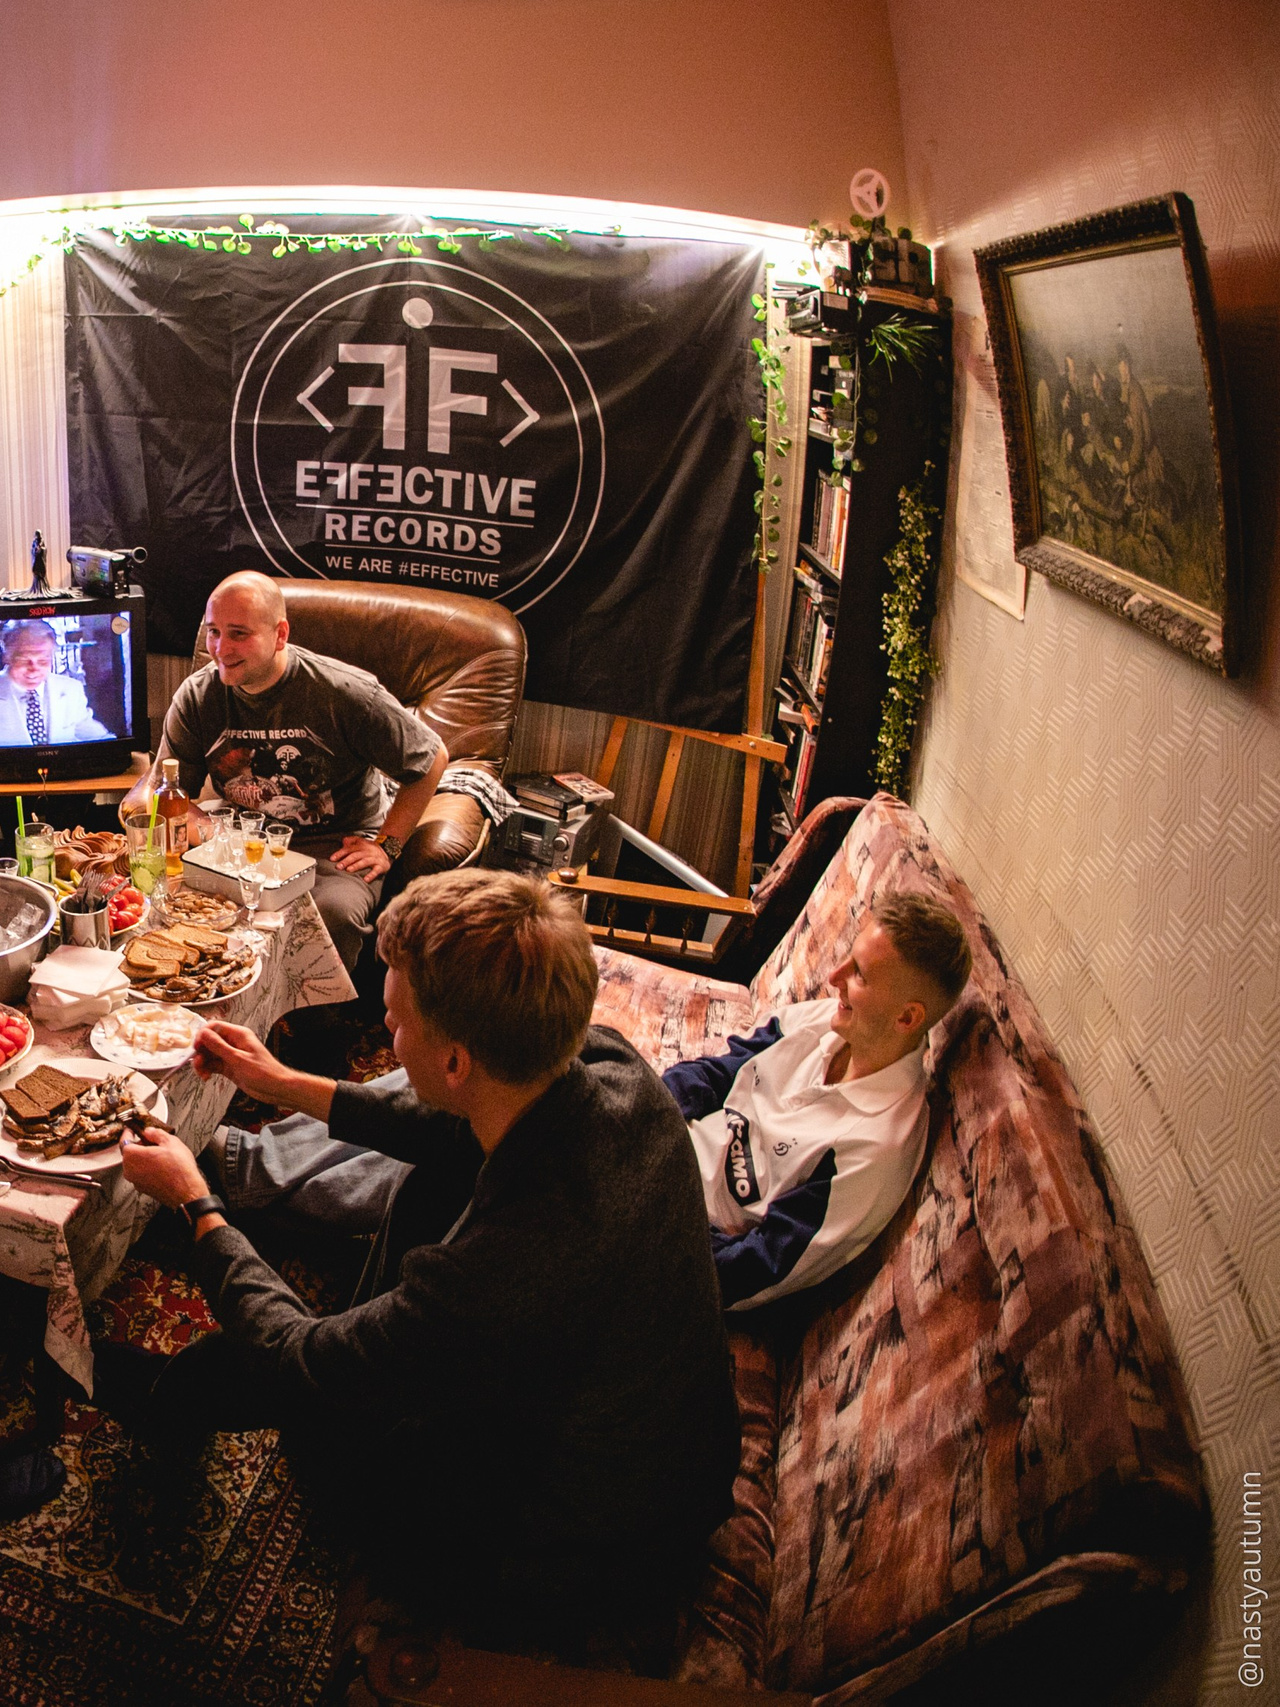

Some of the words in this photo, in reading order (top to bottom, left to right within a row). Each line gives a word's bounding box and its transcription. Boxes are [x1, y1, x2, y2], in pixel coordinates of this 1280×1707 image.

[296, 460, 536, 518] EFFECTIVE
[325, 513, 502, 556] RECORDS
[325, 555, 353, 570] WE
[358, 557, 392, 575] ARE
[398, 561, 500, 588] #EFFECTIVE
